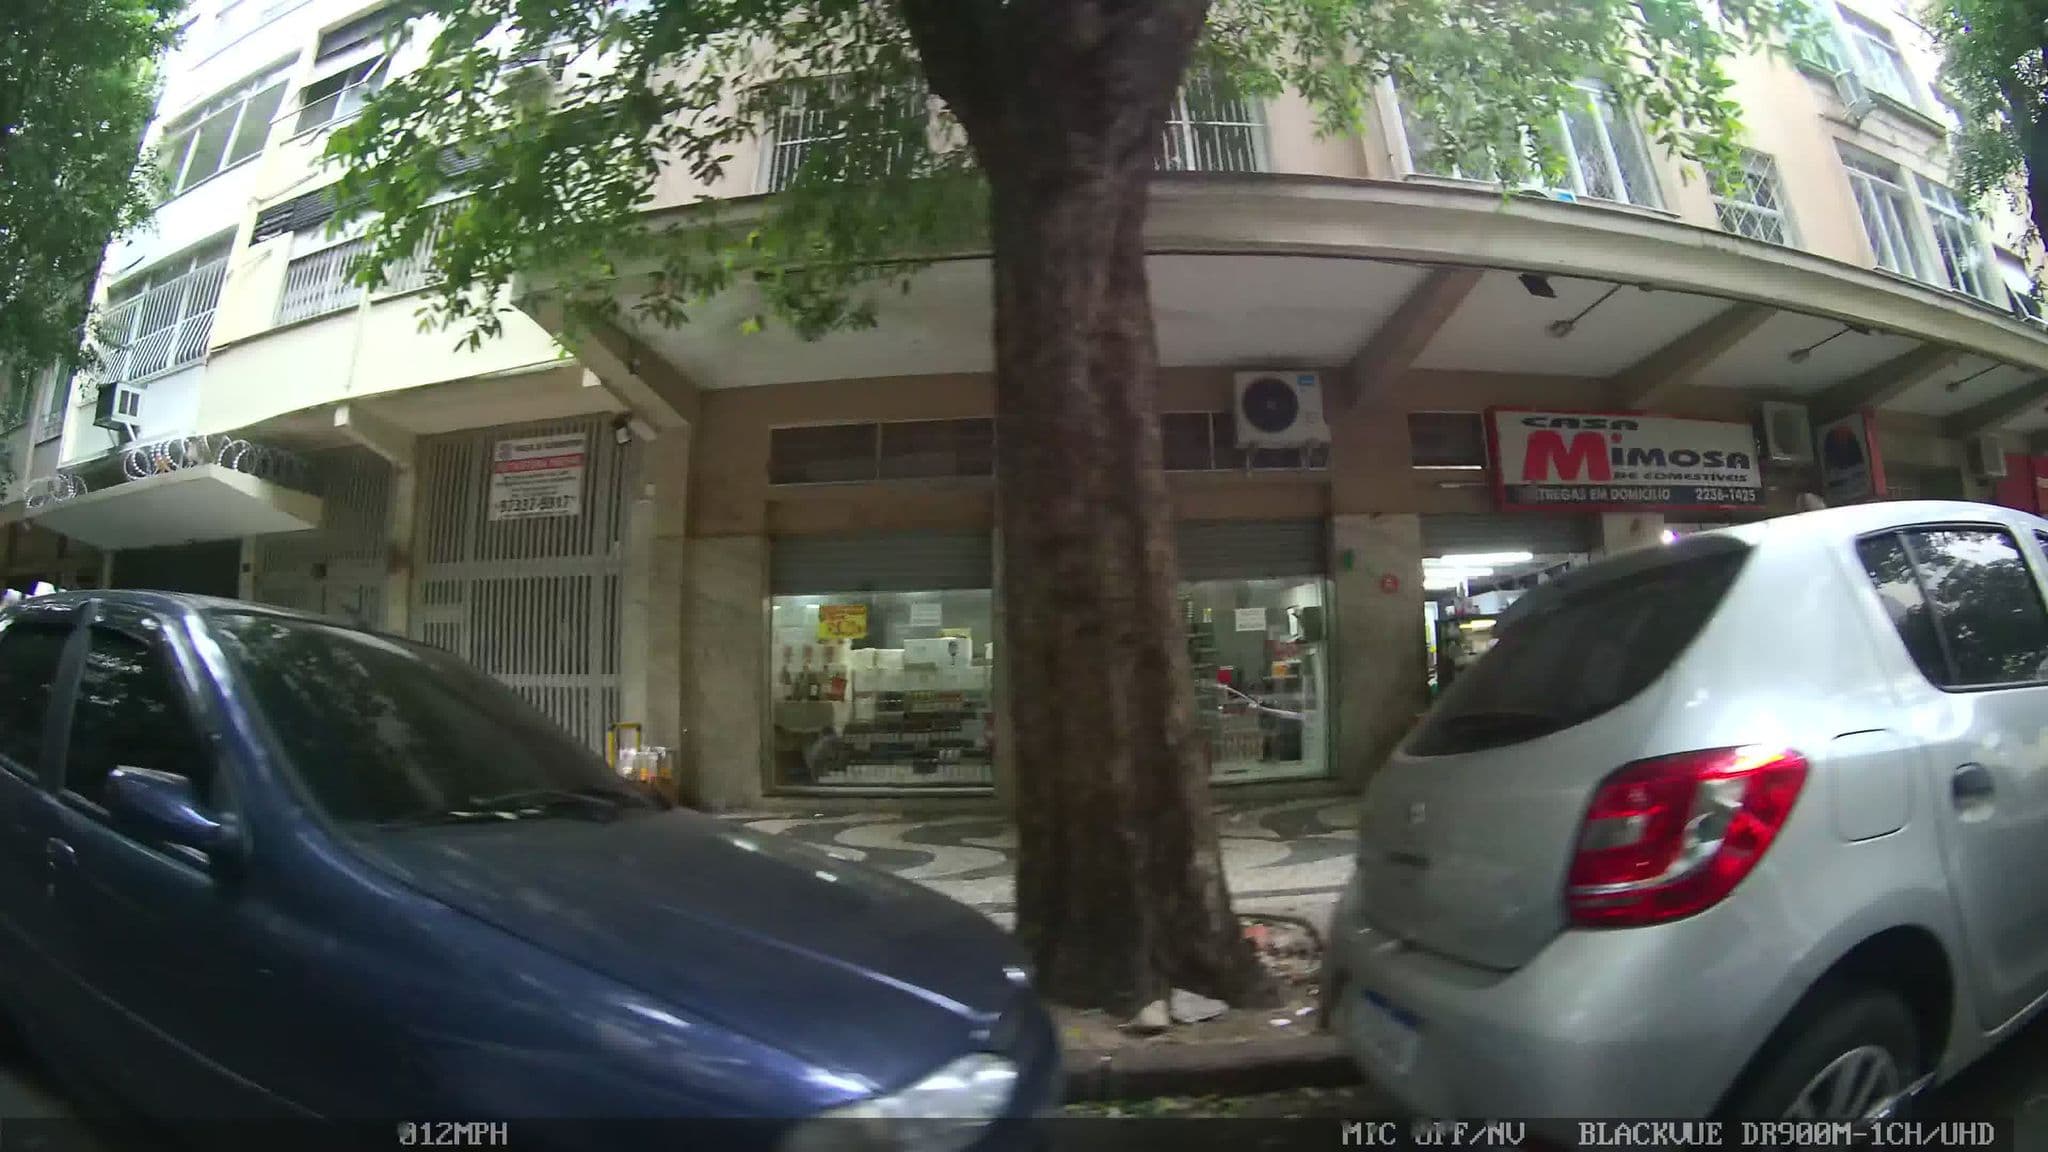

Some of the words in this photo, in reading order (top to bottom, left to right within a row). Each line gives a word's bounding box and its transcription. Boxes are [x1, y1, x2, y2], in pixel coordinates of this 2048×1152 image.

[1521, 416, 1639, 431] CASA
[1613, 471, 1637, 480] DE
[1590, 487, 1608, 501] EM
